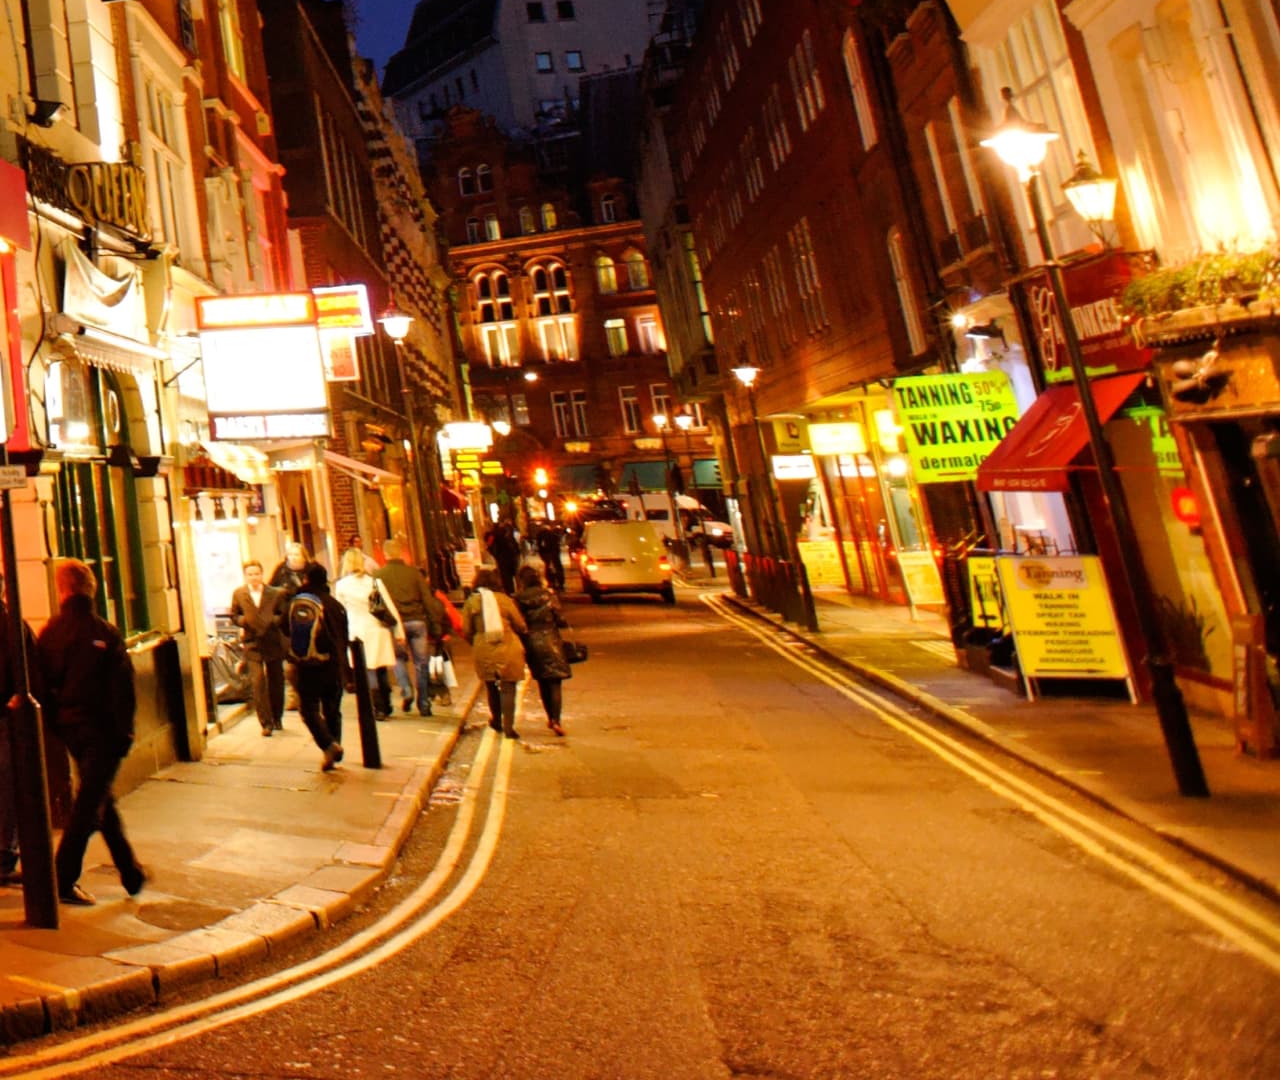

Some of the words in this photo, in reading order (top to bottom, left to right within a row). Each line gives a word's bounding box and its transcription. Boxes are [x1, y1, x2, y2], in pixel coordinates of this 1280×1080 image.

[896, 381, 973, 410] TANNING
[920, 453, 989, 470] dermalo
[1020, 564, 1085, 583] Tanning
